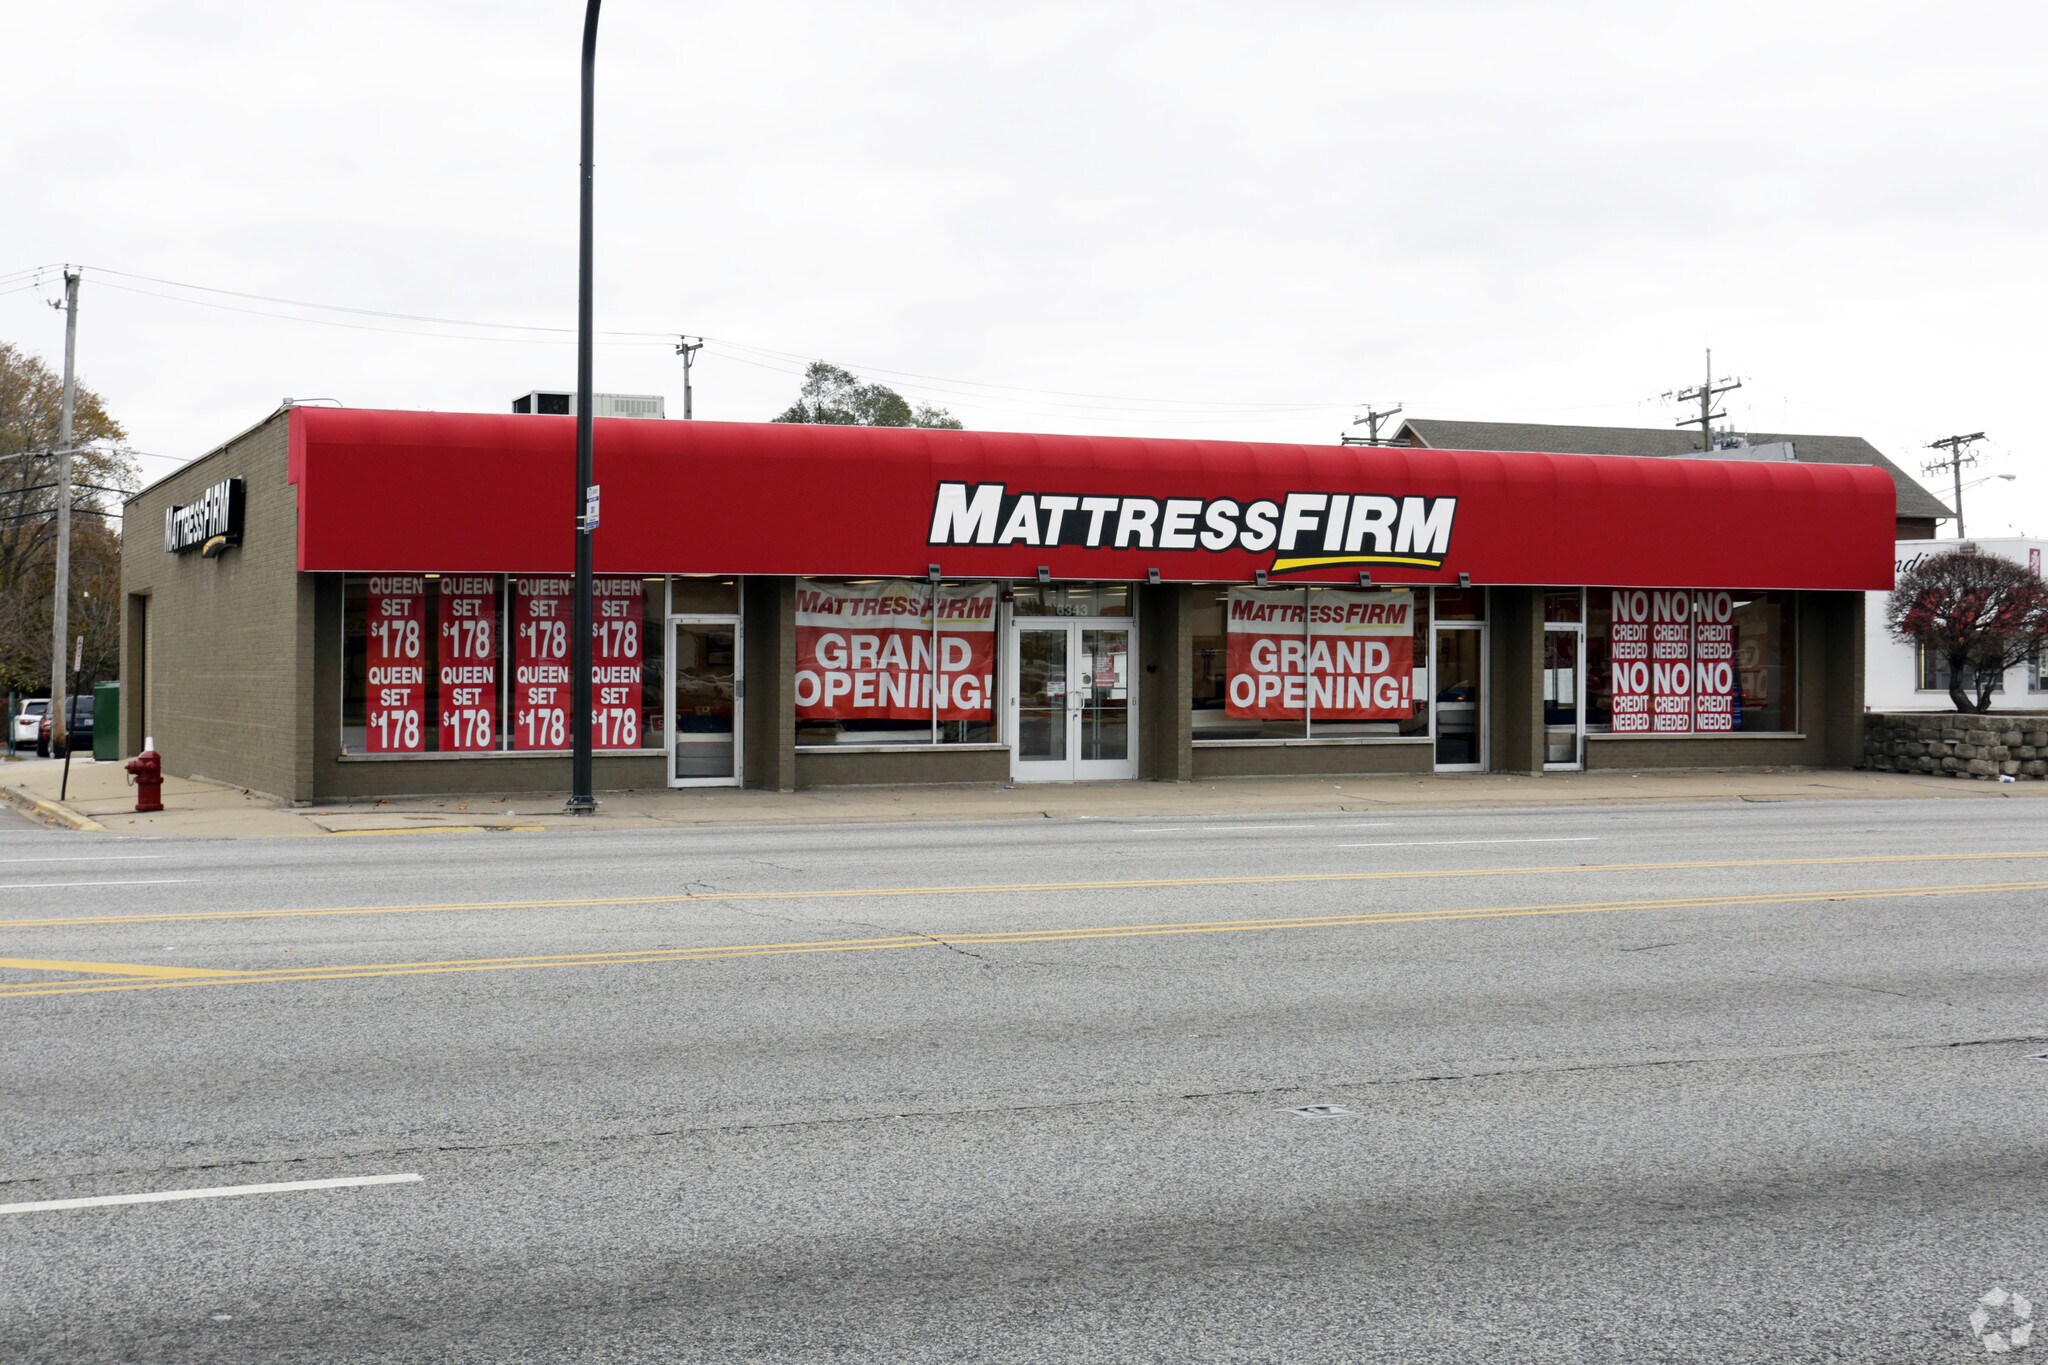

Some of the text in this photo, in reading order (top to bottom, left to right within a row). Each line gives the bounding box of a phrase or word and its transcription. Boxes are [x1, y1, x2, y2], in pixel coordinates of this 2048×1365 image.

[164, 479, 230, 552] MATTRESSFIRM
[929, 483, 1457, 554] MATTRESSFIRM
[370, 577, 423, 595] QUEEN
[441, 577, 493, 595] QUEEN
[518, 578, 569, 596] QUEEN
[592, 579, 641, 596] QUEEN
[381, 599, 411, 616] SET
[452, 599, 482, 617] SET
[529, 600, 556, 617] SET
[601, 600, 629, 617] SET
[1056, 604, 1088, 616] 6343
[1231, 599, 1408, 624] MATTRESSFIRM
[1612, 591, 1649, 623] NO
[1653, 591, 1689, 623] NO
[1697, 592, 1732, 623] NO
[371, 620, 420, 658] $178
[442, 620, 490, 658] $178
[520, 621, 566, 658] $178
[592, 621, 638, 658] $178
[1613, 624, 1648, 641] CREDIT
[1653, 624, 1689, 641] CREDIT
[1697, 625, 1732, 641] CREDIT
[815, 633, 972, 672] GRAND
[1250, 638, 1390, 674] GRAND
[1612, 642, 1648, 659] NEEDED
[1653, 642, 1689, 659] NEEDED
[1697, 643, 1732, 659] NEEDED
[369, 667, 422, 685] QUEEN
[441, 666, 493, 684] QUEEN
[517, 666, 569, 684] QUEEN
[592, 666, 640, 684] QUEEN
[1612, 662, 1649, 694] NO
[1653, 662, 1690, 694] NO
[1697, 662, 1733, 694] NO
[380, 689, 411, 706] SET
[452, 688, 482, 705] SET
[528, 687, 557, 705] SET
[600, 687, 629, 705] SET
[795, 670, 993, 710] OPENING!
[1229, 673, 1410, 709] OPENING!
[1613, 695, 1649, 713] CREDIT
[1654, 696, 1690, 713] CREDIT
[1697, 695, 1732, 712] CREDIT
[371, 709, 420, 748] $178
[443, 709, 491, 747] $178
[519, 708, 565, 746] $178
[592, 708, 637, 746] $178
[1613, 714, 1649, 731] NEEDED
[1654, 714, 1689, 731] NEEDED
[1697, 713, 1732, 731] NEEDED
